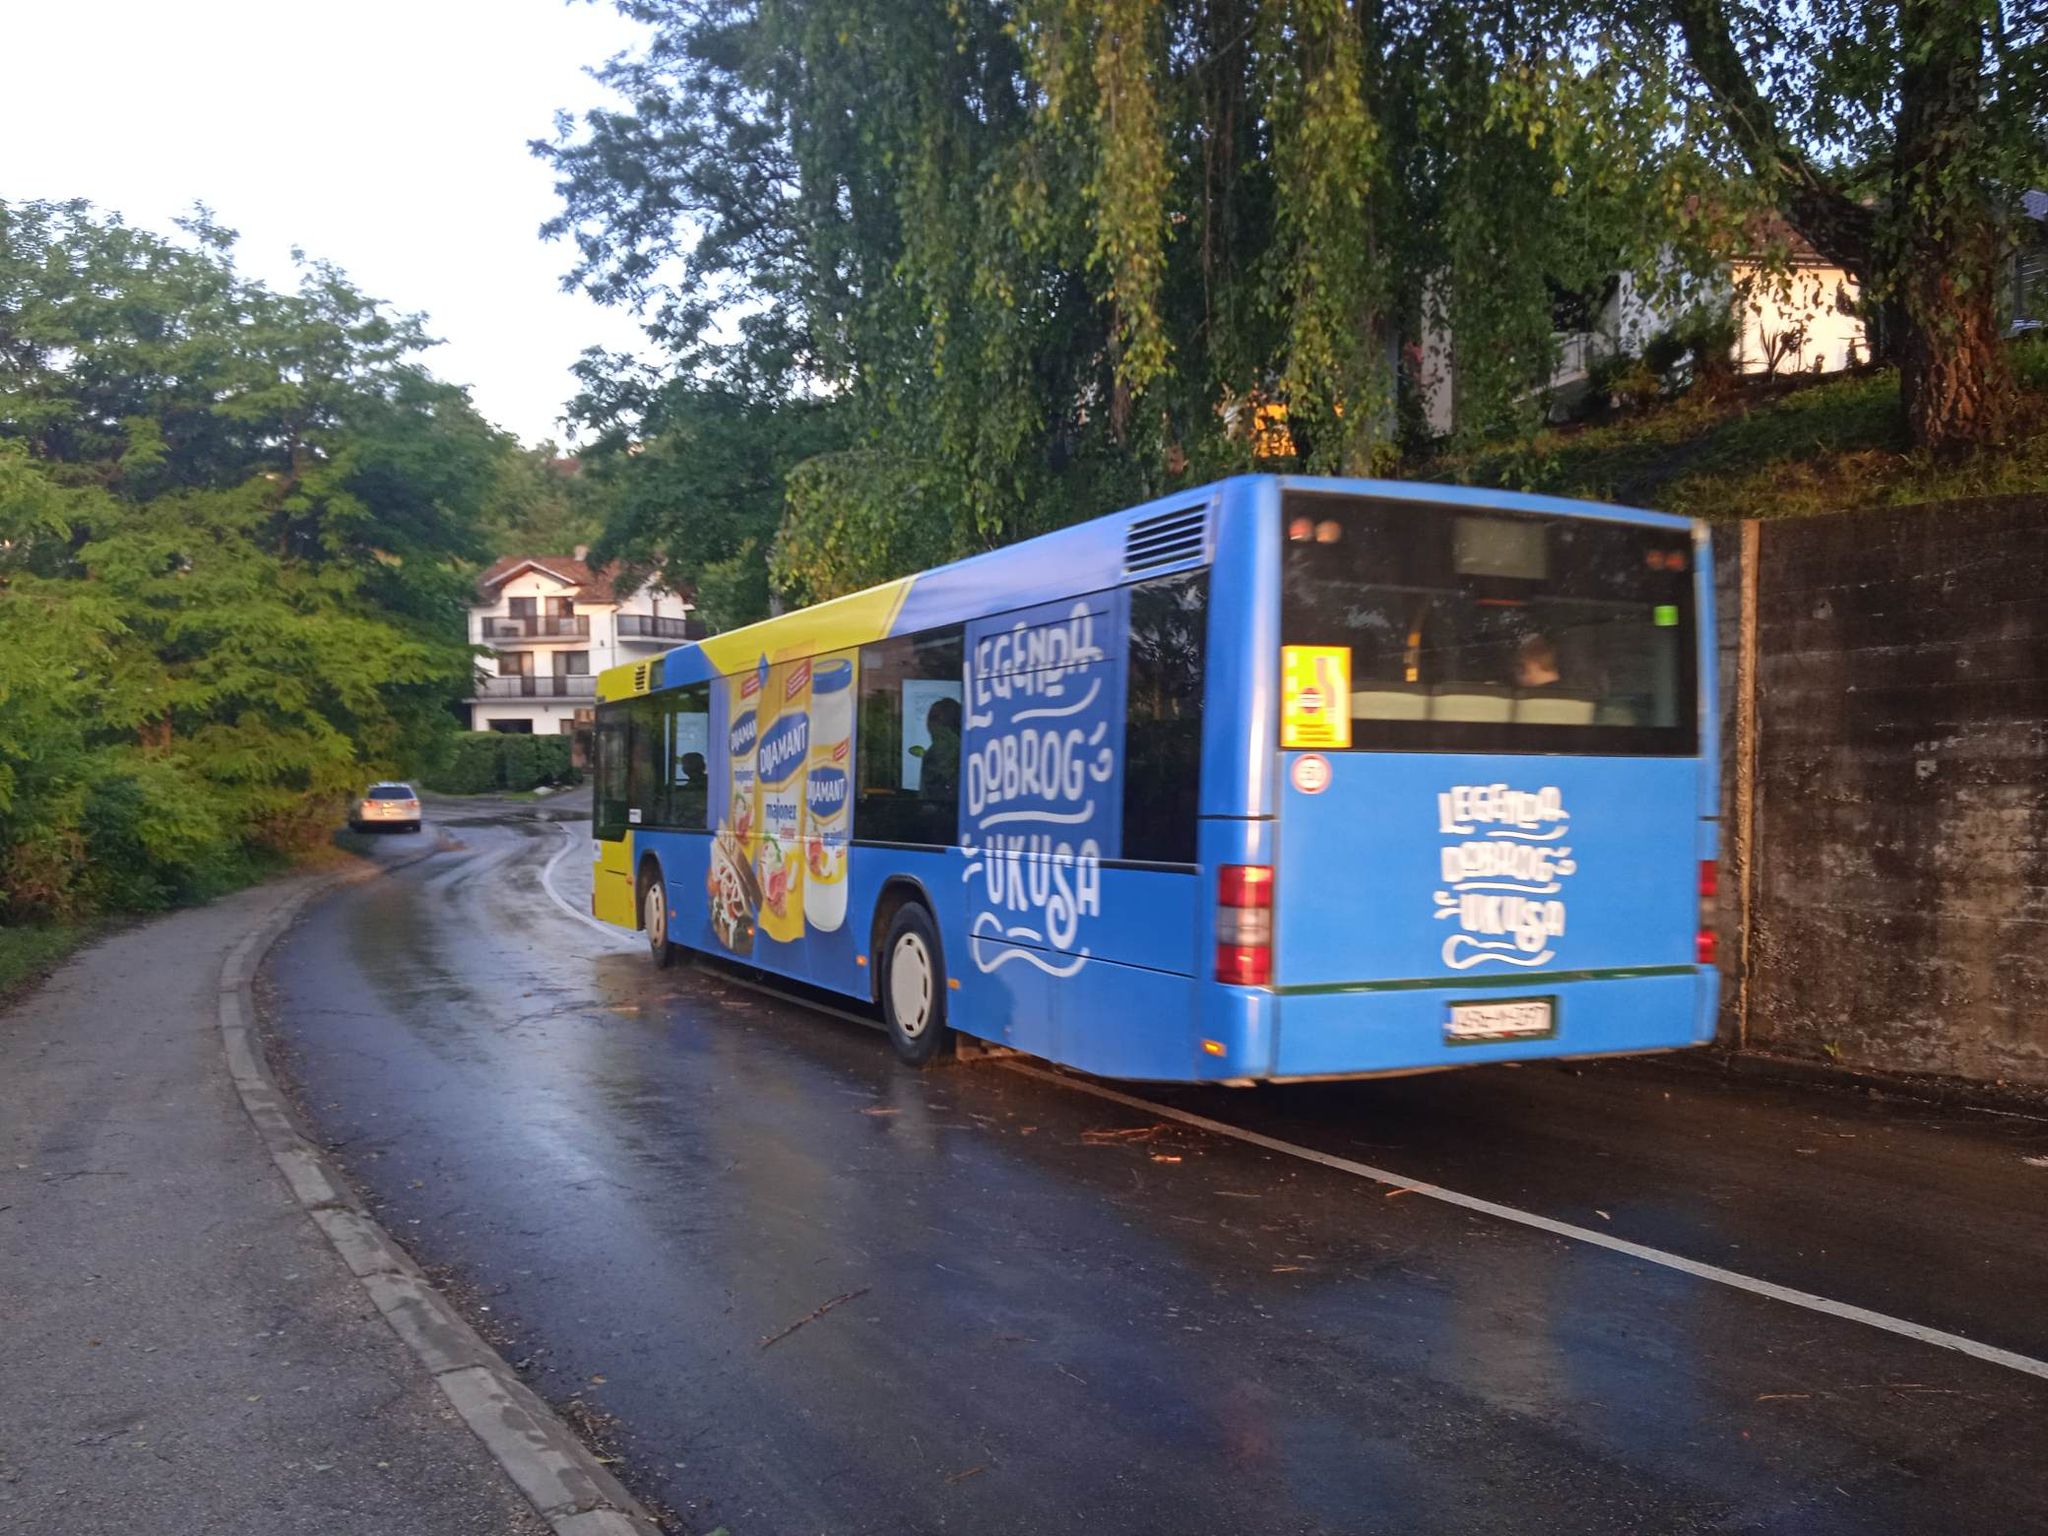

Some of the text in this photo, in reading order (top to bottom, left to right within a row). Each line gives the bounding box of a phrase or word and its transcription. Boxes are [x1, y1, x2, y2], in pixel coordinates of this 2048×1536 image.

[963, 601, 1103, 731] LEGENDA
[730, 719, 757, 752] DIJAMAN
[760, 722, 807, 776] DIJAMANT
[967, 728, 1085, 817] DOBROG
[765, 798, 797, 825] majonez
[985, 833, 1100, 950] UKUSA
